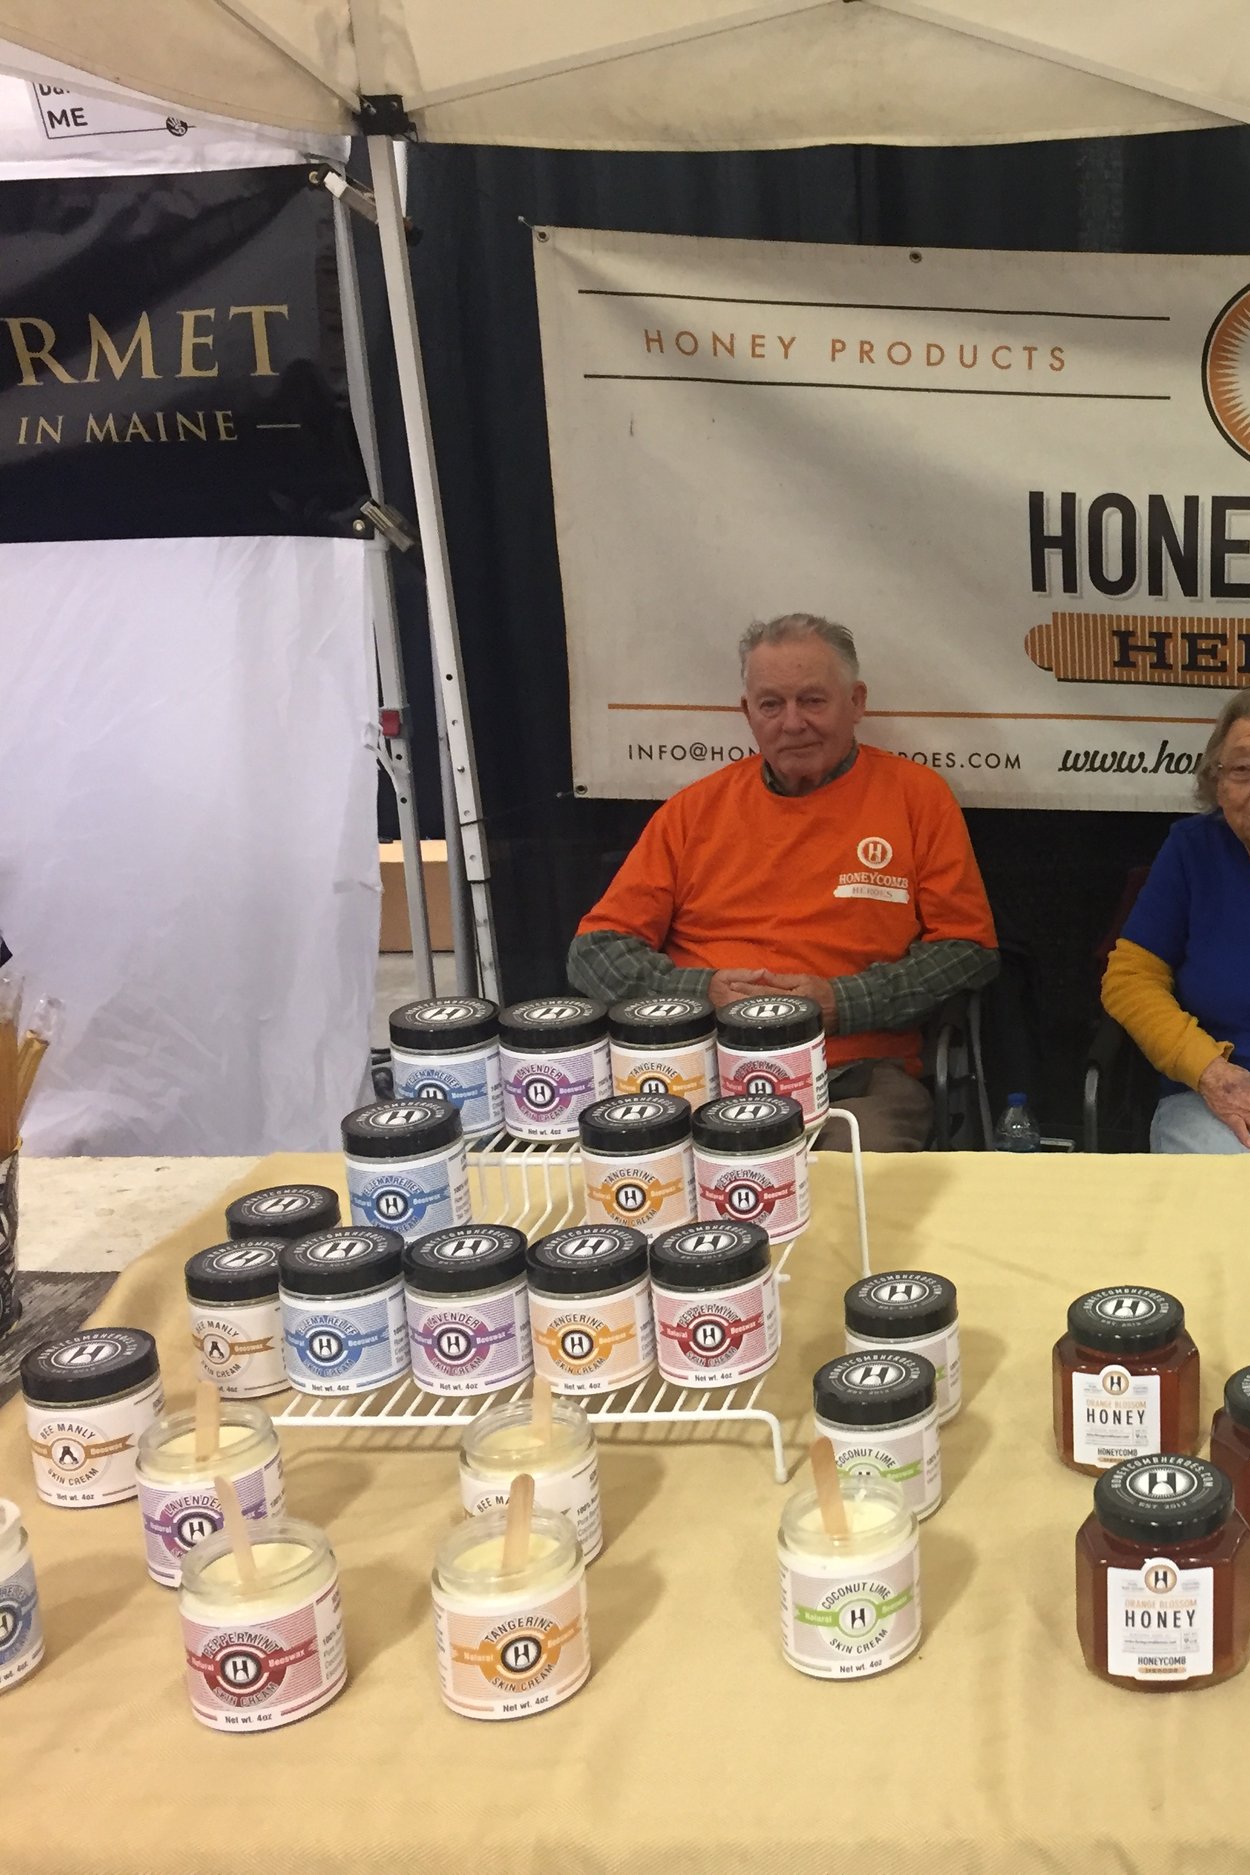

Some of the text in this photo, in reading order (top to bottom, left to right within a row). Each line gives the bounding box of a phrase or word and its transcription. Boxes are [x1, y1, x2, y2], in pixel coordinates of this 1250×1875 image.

[47, 107, 88, 129] ME
[1, 304, 290, 387] RMET
[644, 328, 1068, 372] HONEY PRODUCTS
[16, 410, 238, 446] IN MAINE
[839, 872, 909, 888] HONEYCOMB
[517, 1064, 563, 1080] LAVENDER
[630, 1063, 678, 1078] TANGERINE
[604, 1168, 655, 1184] TANGERINE
[716, 1168, 772, 1189] PEPPERMINT
[428, 1312, 480, 1328] LAVENDER
[550, 1314, 603, 1330] TANGERINE
[678, 1304, 741, 1326] PEPPERMINT
[207, 1321, 239, 1339] MANLY
[708, 1347, 737, 1367] CREAM
[578, 1358, 606, 1376] CREAM
[695, 1374, 706, 1382] Net
[1086, 1409, 1145, 1425] HONEY
[40, 1423, 96, 1440] BEE MANLY
[836, 1448, 896, 1469] COCONUT LIME
[1098, 1448, 1138, 1456] HONEYCOMB
[47, 1468, 99, 1486] SKIN CREAM
[477, 1497, 492, 1513] BEE
[821, 1582, 892, 1610] COCONUT LIME
[1125, 1609, 1196, 1628] HONEY
[484, 1616, 554, 1642] TANGERINE
[203, 1632, 282, 1657] PEPPERMINT
[829, 1628, 889, 1654] SKIN CREAM
[839, 1665, 853, 1674] Net
[869, 1659, 883, 1668] 4oz
[1138, 1657, 1186, 1666] HONEYCOMB
[491, 1664, 555, 1692] SKIN CREAM
[213, 1682, 278, 1707] SKIN CREAM
[503, 1704, 517, 1712] Net
[535, 1695, 549, 1705] 4oz
[225, 1716, 239, 1724] Net
[257, 1713, 272, 1722] 4oz
